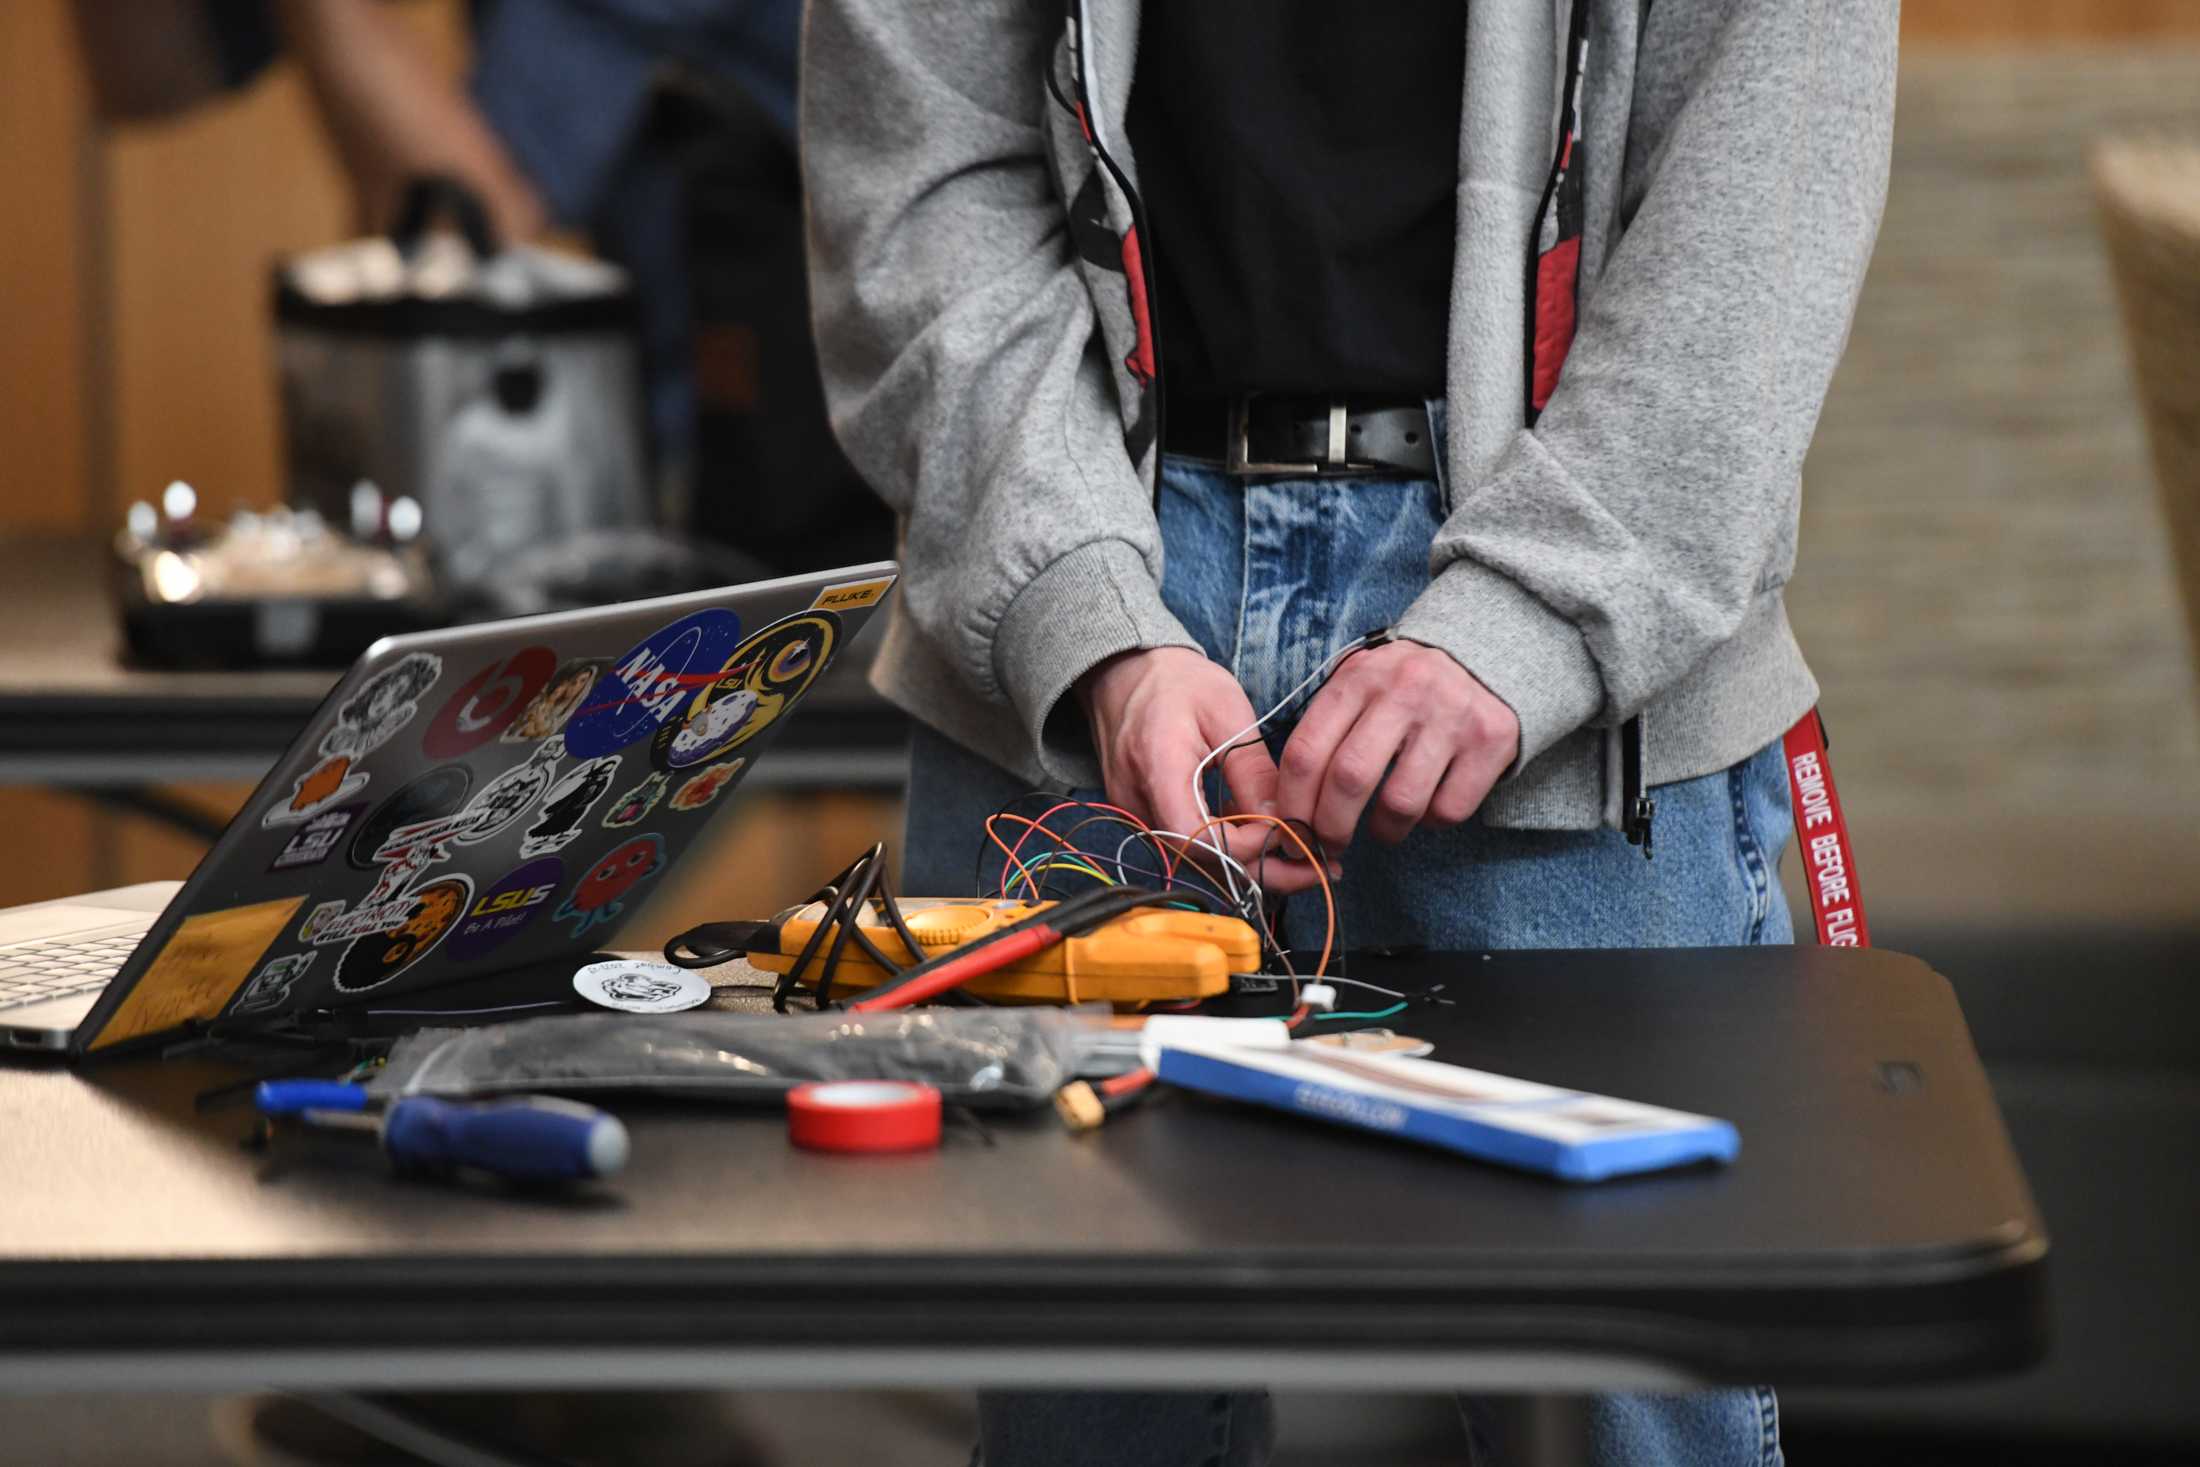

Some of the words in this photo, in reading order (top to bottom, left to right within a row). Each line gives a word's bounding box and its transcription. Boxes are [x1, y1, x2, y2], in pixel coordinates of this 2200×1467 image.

[615, 647, 688, 723] NASA
[716, 678, 744, 689] LSU
[1793, 751, 1832, 830] REMOVE
[283, 827, 345, 853] LSU
[1811, 832, 1850, 908] BEFORE
[470, 883, 556, 917] LSUS
